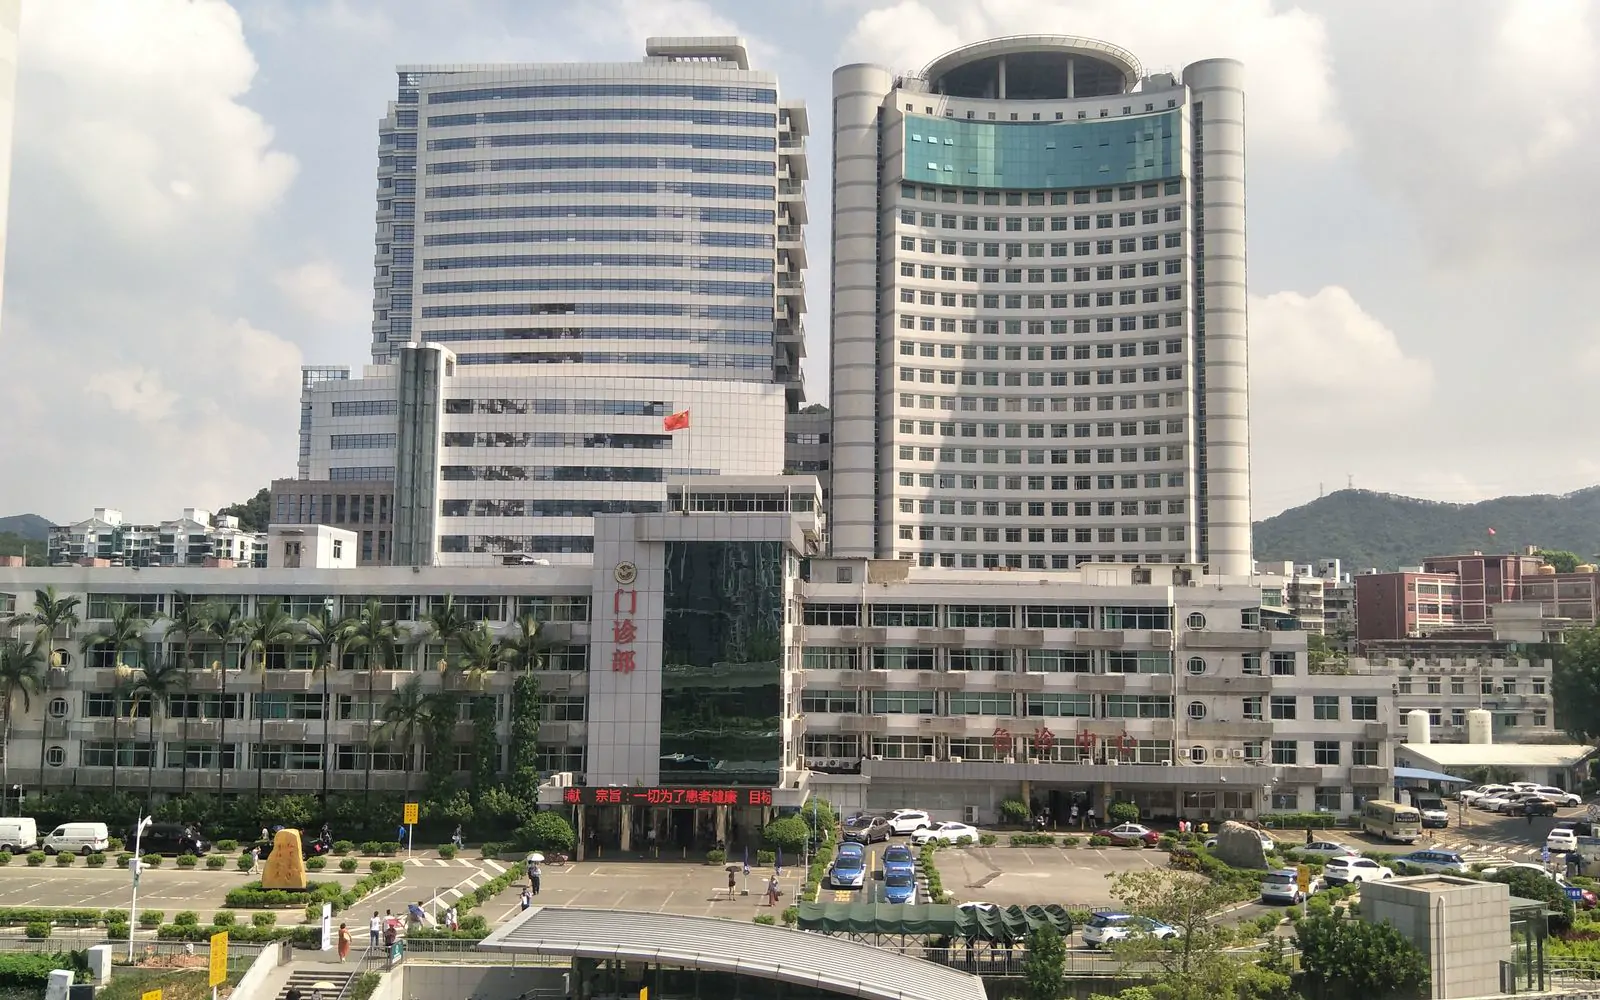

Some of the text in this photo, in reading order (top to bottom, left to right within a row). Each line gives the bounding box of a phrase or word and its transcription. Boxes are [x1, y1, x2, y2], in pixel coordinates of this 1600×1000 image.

[612, 588, 638, 674] 门诊部
[992, 727, 1138, 752] 急诊中心
[564, 789, 581, 803] 献
